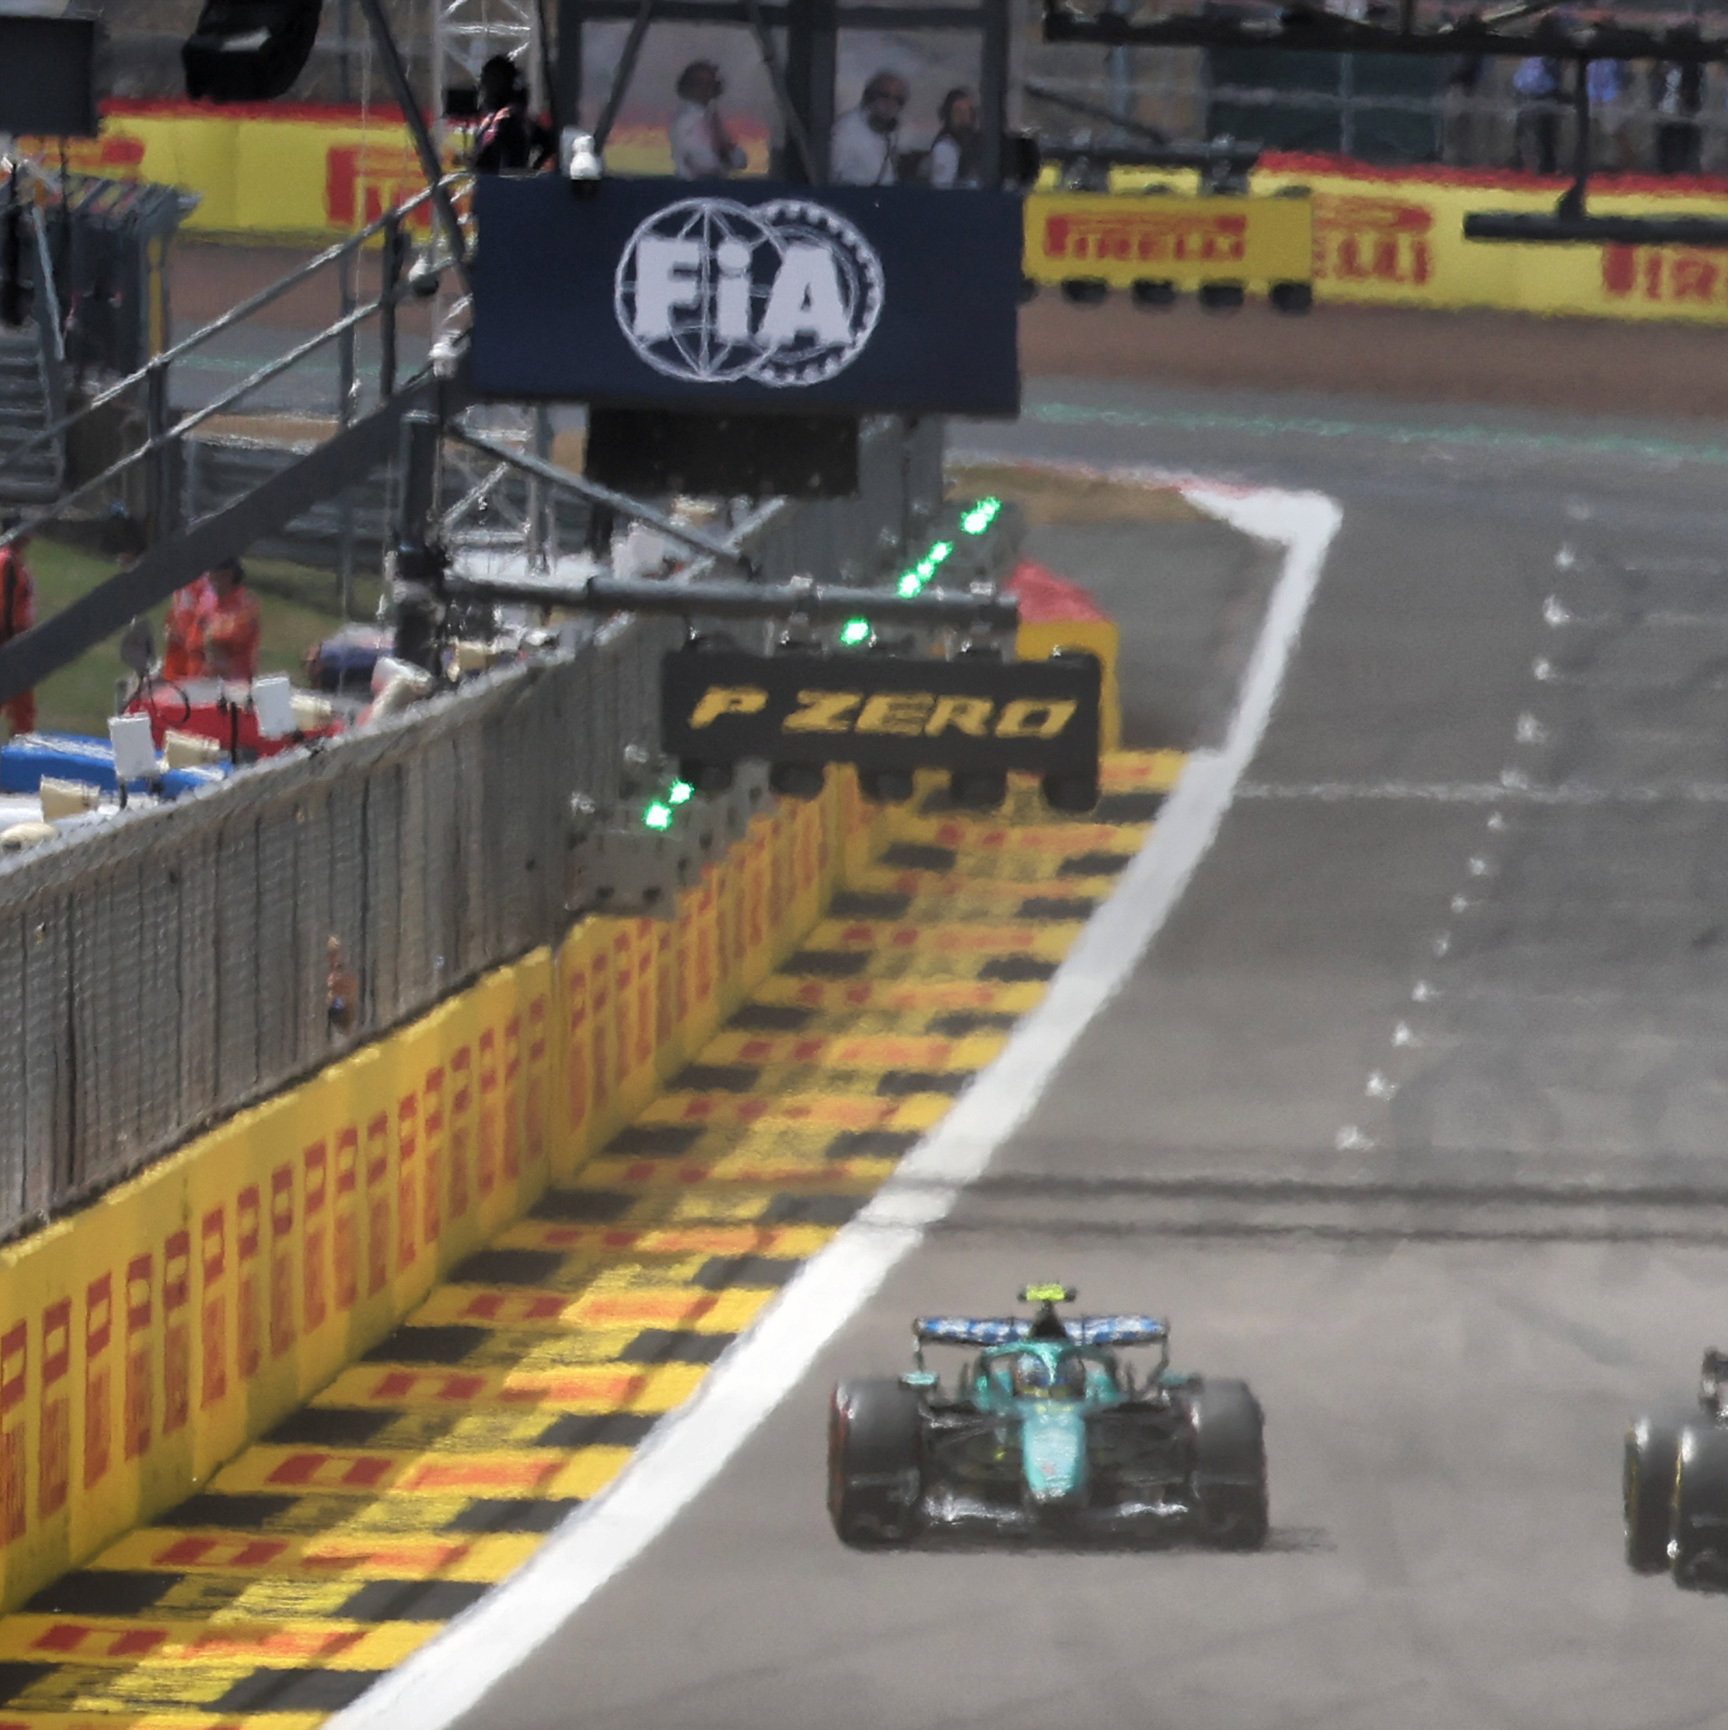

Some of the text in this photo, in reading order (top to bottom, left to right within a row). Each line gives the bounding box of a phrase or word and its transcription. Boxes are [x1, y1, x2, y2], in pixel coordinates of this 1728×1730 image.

[1044, 214, 1248, 263] PIRELLI
[688, 684, 1078, 739] P ZERO
